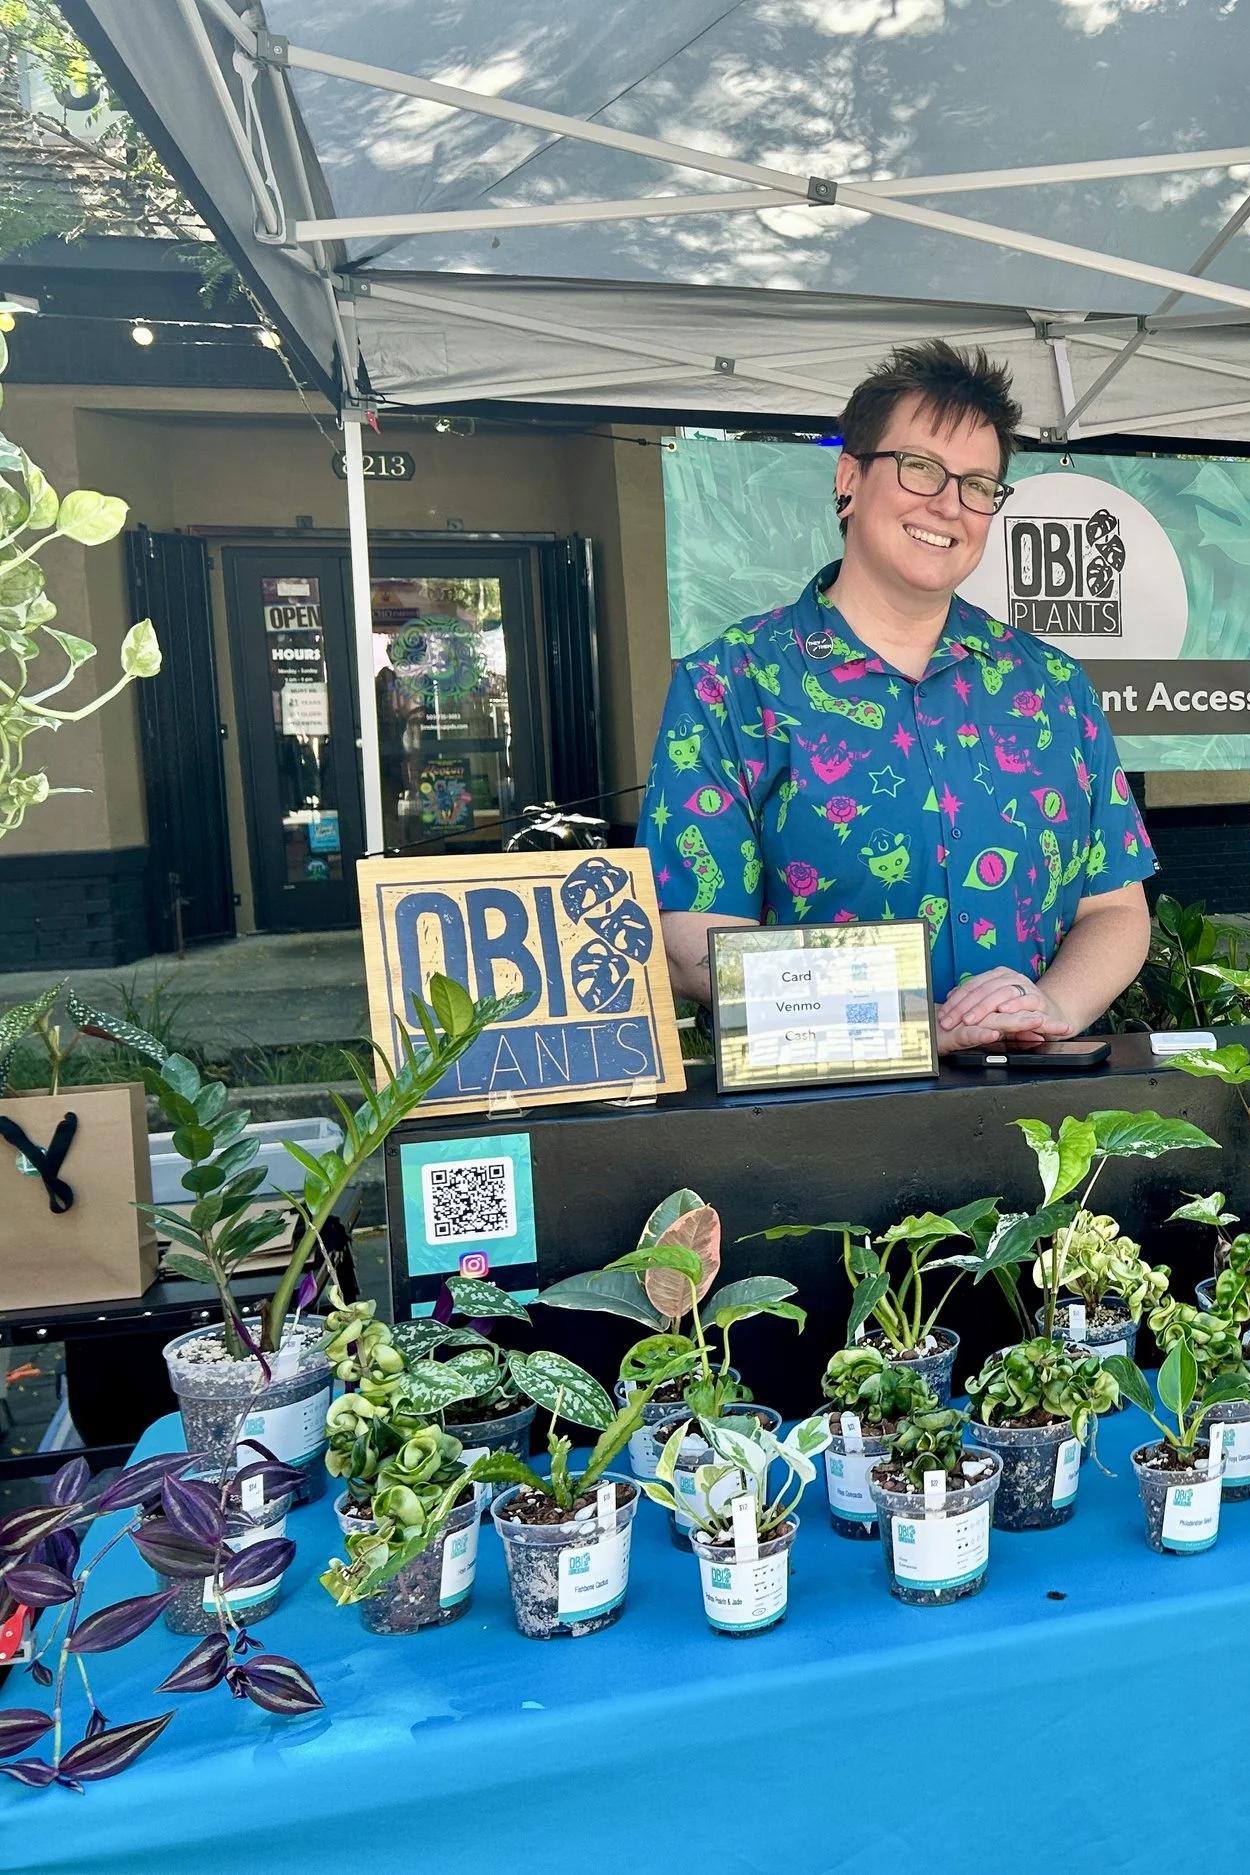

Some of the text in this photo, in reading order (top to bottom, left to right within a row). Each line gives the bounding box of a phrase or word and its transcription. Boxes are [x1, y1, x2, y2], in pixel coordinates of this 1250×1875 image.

[1011, 522, 1084, 598] OBI
[269, 605, 322, 629] OPEN
[1014, 602, 1117, 632] PLANTS
[271, 648, 321, 661] HOURS
[395, 886, 568, 1029] OBI
[781, 970, 812, 983] Card
[775, 1001, 821, 1012] Venmo
[785, 1029, 816, 1042] Cash
[412, 1022, 648, 1093] LANTS
[574, 1579, 609, 1594] Fishbone Cactus
